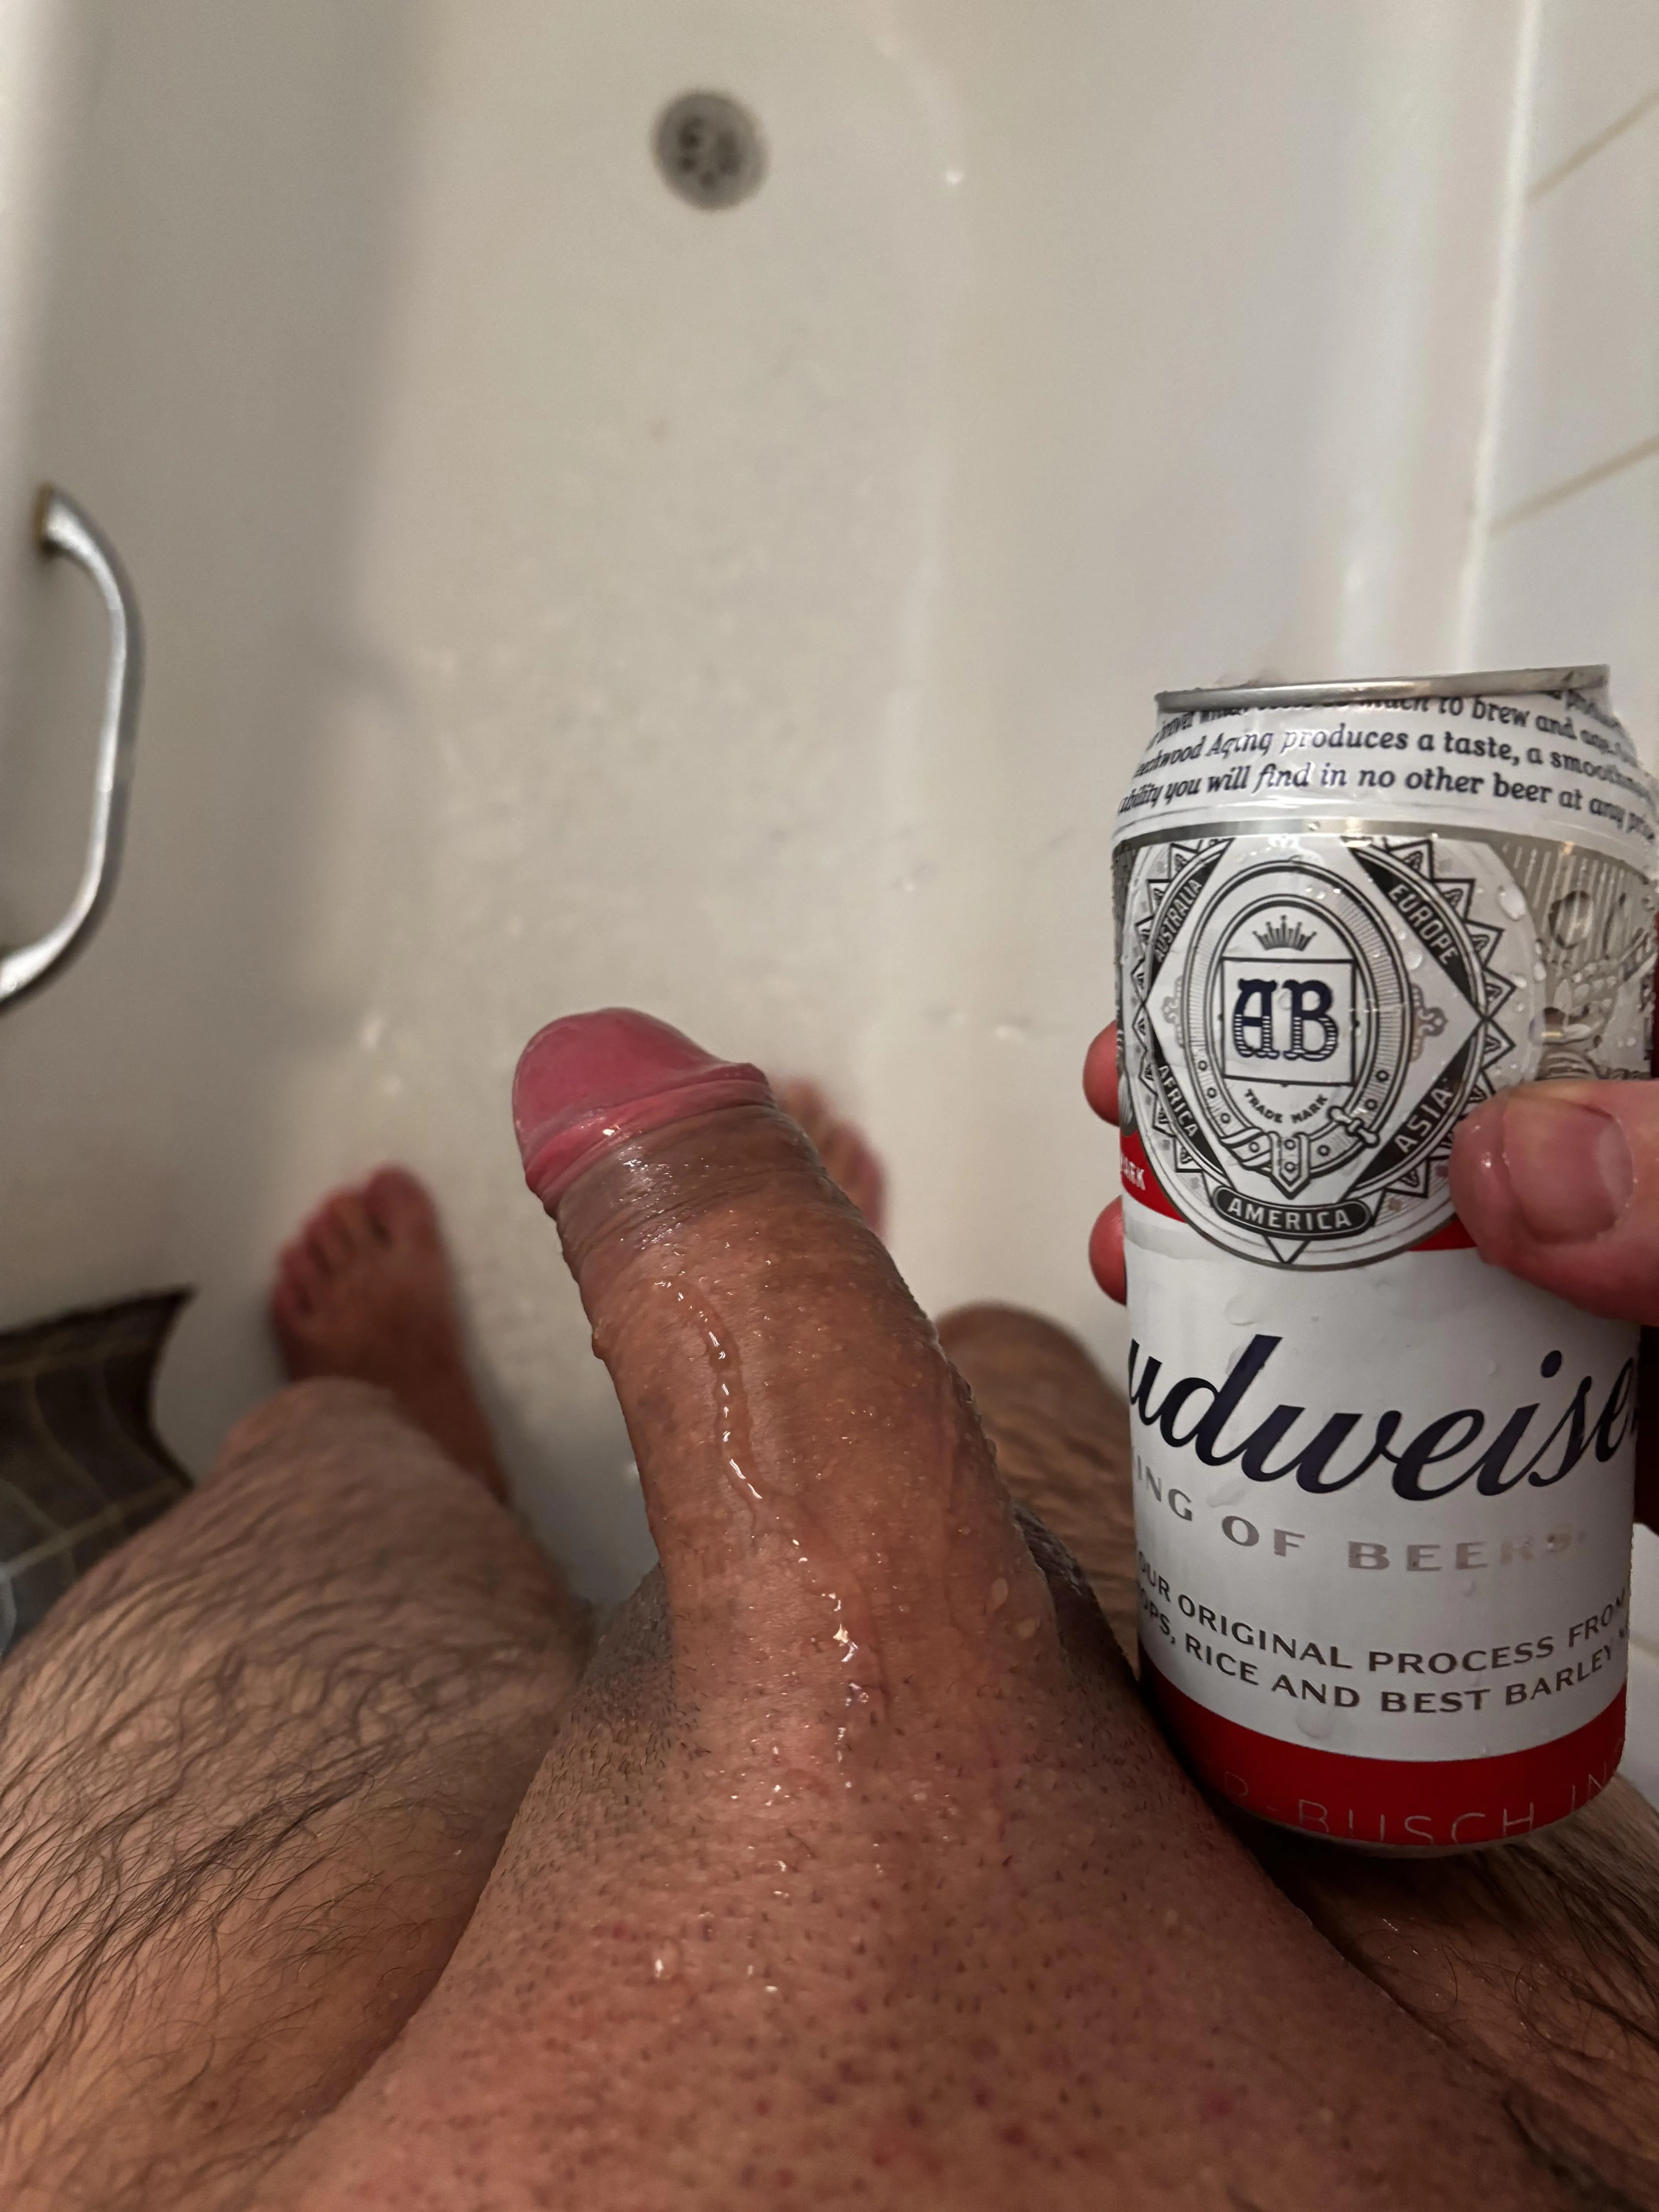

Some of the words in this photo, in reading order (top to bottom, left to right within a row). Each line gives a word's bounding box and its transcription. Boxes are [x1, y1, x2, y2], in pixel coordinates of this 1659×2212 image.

[1205, 732, 1274, 759] Aging
[1280, 722, 1409, 753] produces
[1418, 733, 1434, 751] a
[1444, 732, 1520, 766] taste,
[1527, 747, 1543, 765] a
[1438, 696, 1464, 716] to
[1472, 695, 1531, 728] brew
[1535, 716, 1577, 740] and
[1164, 777, 1202, 805] you
[1207, 765, 1252, 793] will
[1252, 761, 1310, 793] find
[1321, 763, 1346, 787] in
[1358, 770, 1396, 788] no
[1405, 766, 1484, 794] other
[1494, 772, 1552, 804] beer
[1558, 788, 1583, 811] at
[1154, 879, 1202, 963] AUSTRALIA
[1388, 883, 1459, 965] EUROPE
[1233, 978, 1339, 1062] AB
[1158, 1065, 1199, 1137] AFRICA
[1244, 1089, 1283, 1124] TRADE
[1291, 1094, 1329, 1123] MARK
[1394, 1088, 1455, 1154] ASIA
[1228, 1198, 1352, 1231] AMERICA
[1222, 1515, 1306, 1558] OF
[1178, 1594, 1352, 1669] ORIGINAL
[1368, 1636, 1554, 1674] PROCESS
[1185, 1633, 1259, 1686] RICE
[1271, 1674, 1360, 1707] AND
[1380, 1688, 1490, 1714] BEST
[1505, 1642, 1613, 1706] BARLEY
